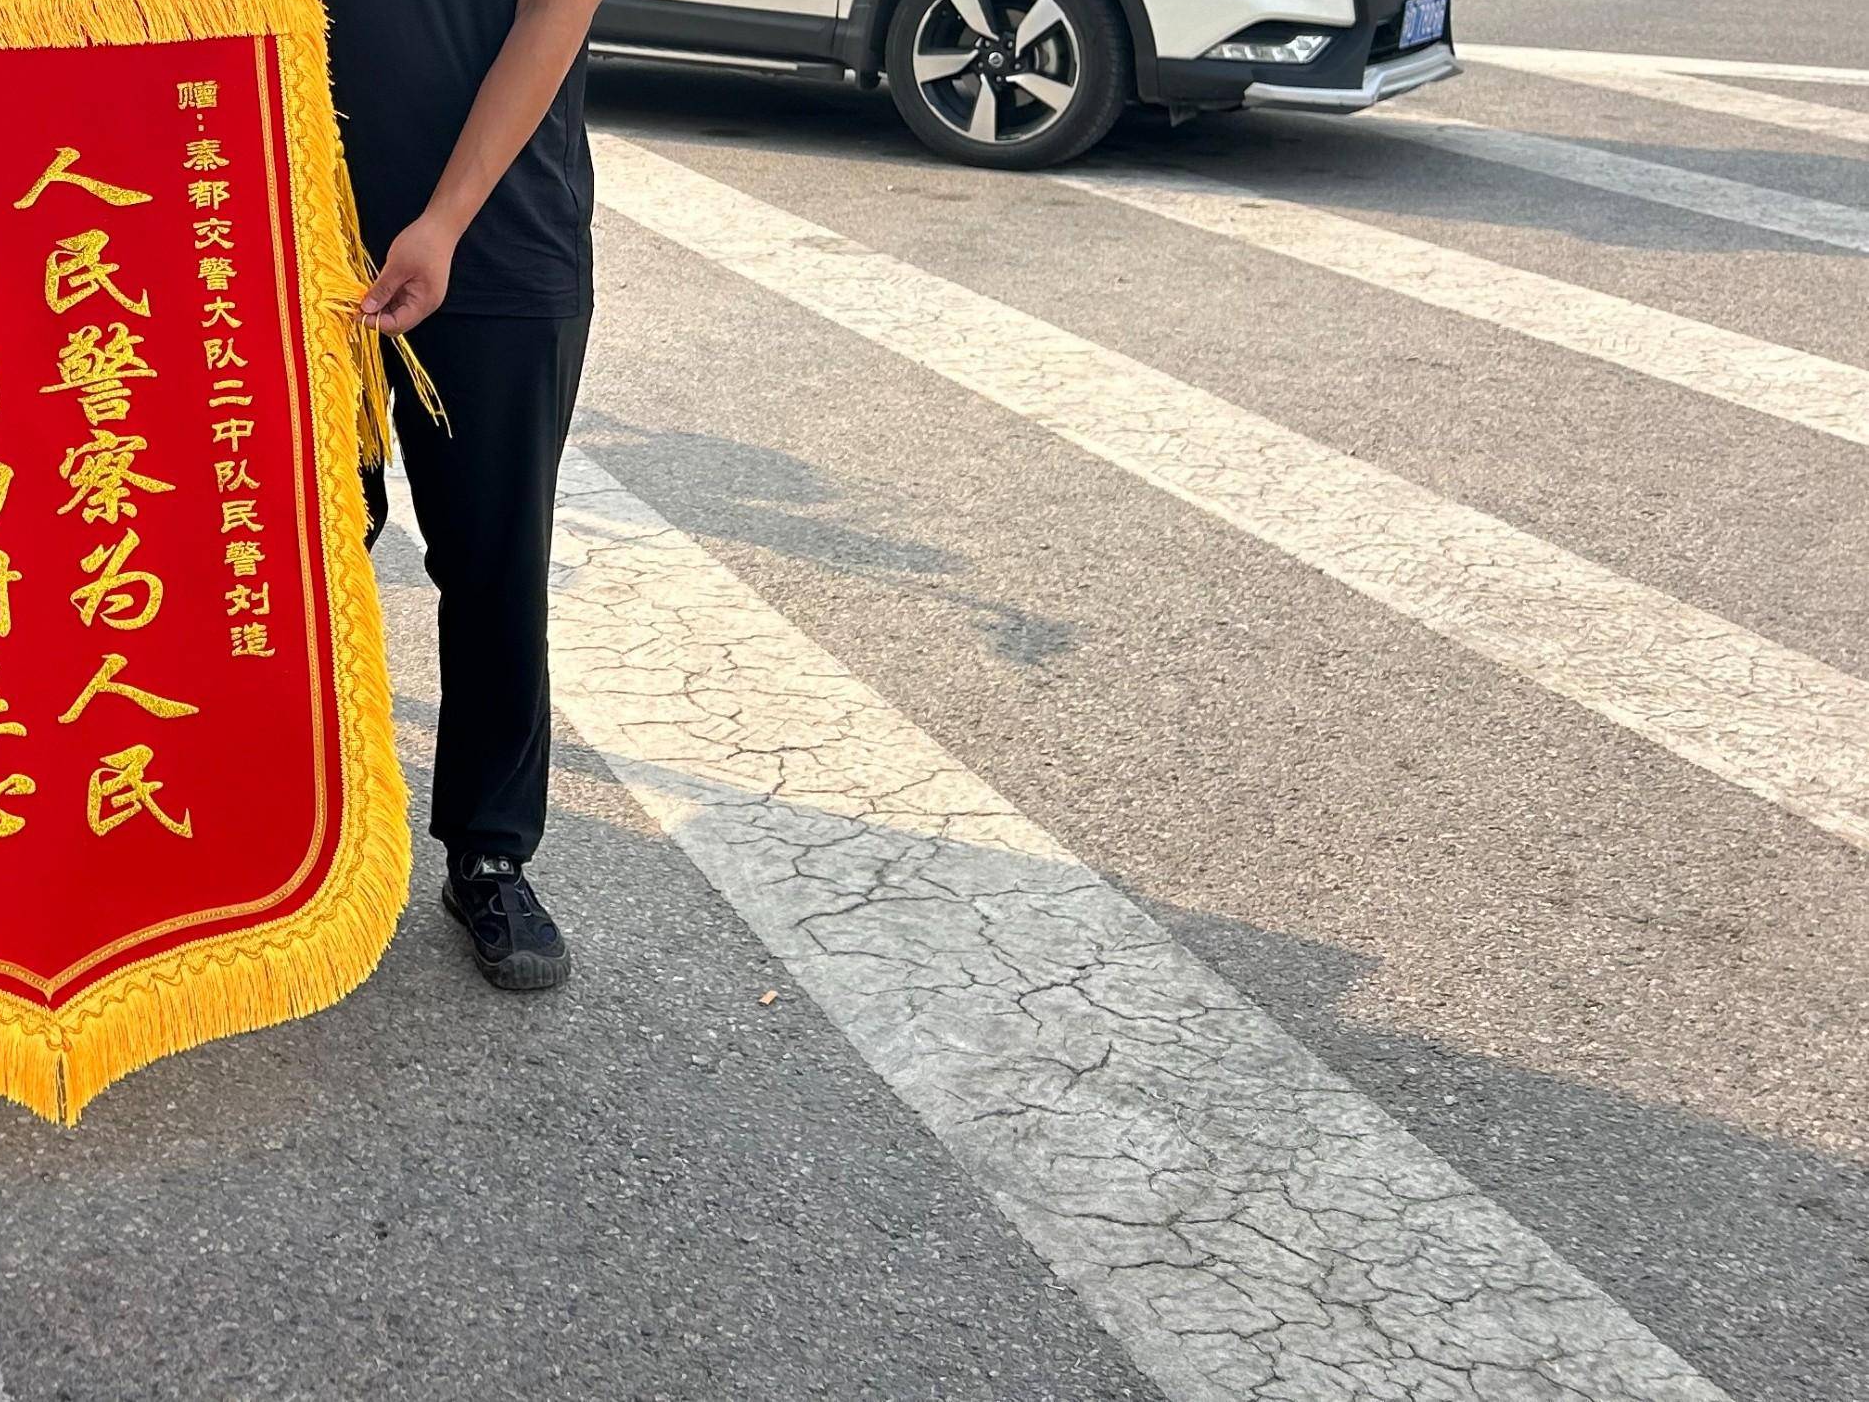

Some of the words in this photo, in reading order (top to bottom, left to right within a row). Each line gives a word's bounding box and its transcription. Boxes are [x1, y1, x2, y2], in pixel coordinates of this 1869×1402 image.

[13, 146, 200, 839] 人民警察为人民
